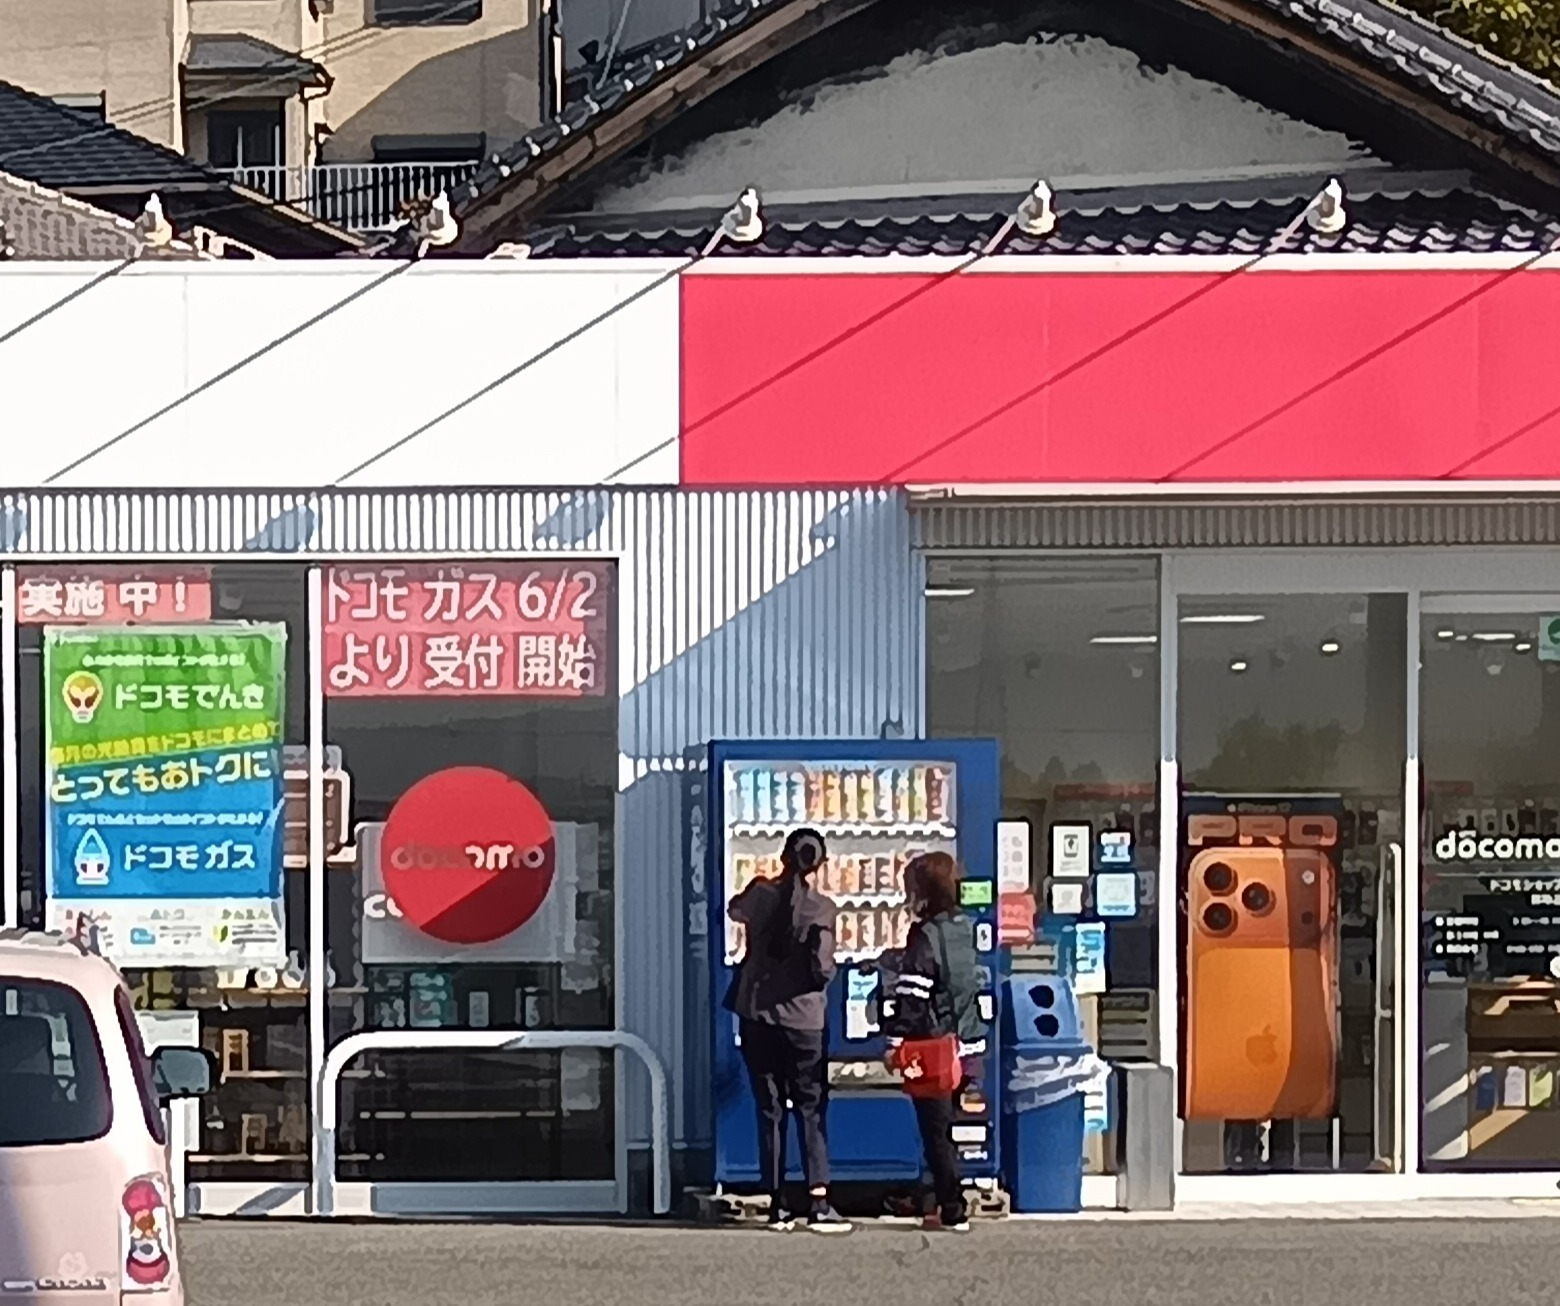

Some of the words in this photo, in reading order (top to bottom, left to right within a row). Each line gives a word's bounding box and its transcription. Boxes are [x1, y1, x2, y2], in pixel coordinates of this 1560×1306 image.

[115, 683, 265, 710] ドコモでんき
[51, 751, 272, 803] とってもおトクに
[1187, 814, 1338, 846] PRO
[124, 839, 256, 871] ドコモガス
